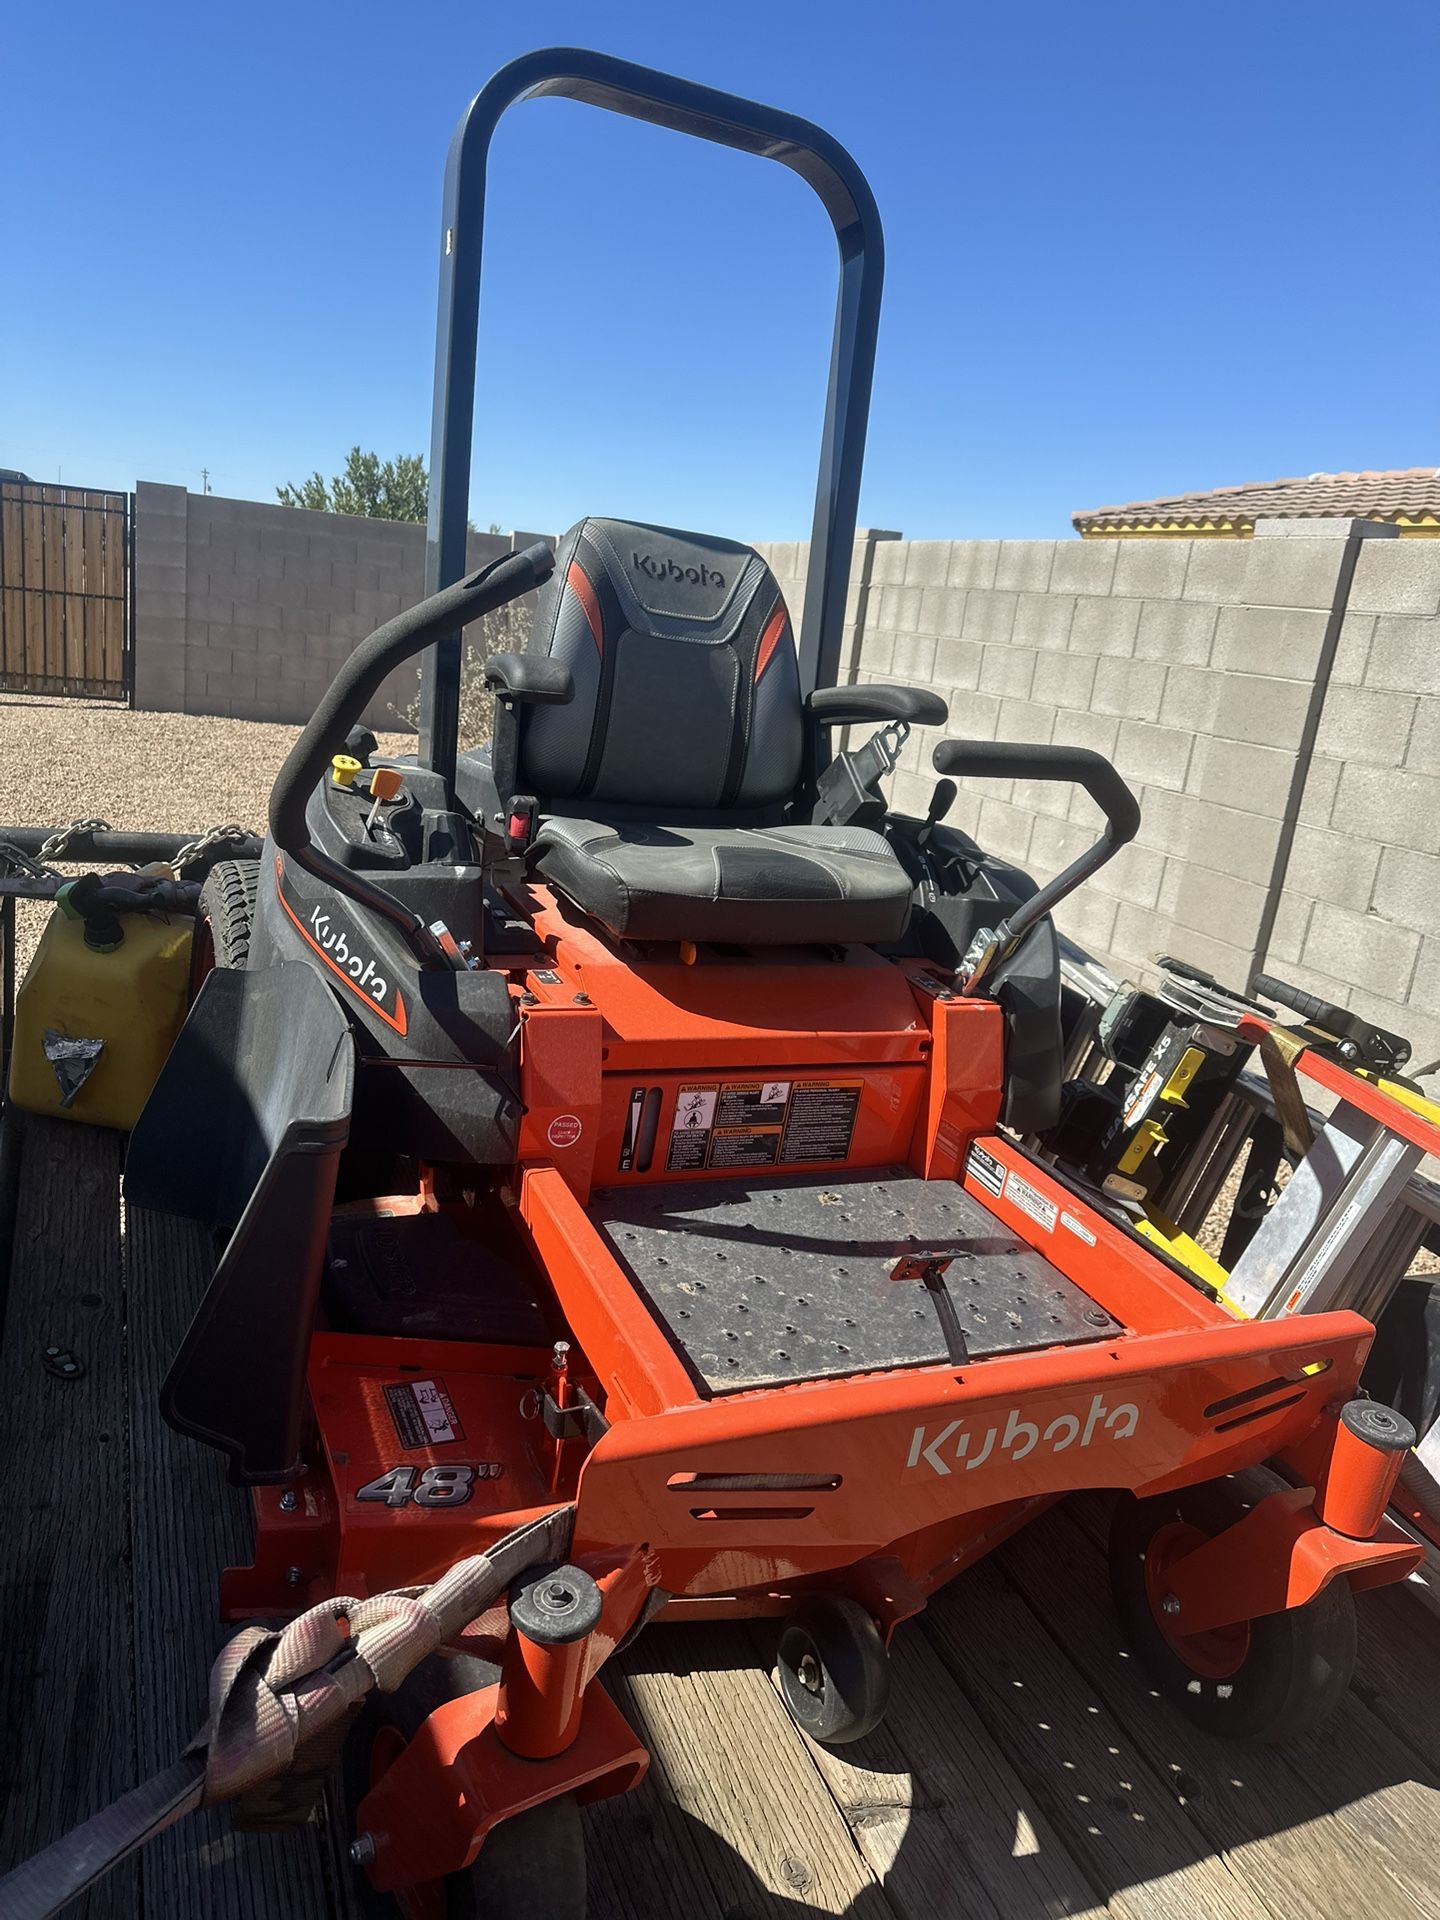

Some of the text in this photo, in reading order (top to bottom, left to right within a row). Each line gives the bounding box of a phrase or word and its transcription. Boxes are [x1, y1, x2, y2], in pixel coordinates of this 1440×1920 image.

[633, 552, 725, 588] Kubota
[310, 905, 387, 1001] Kubota
[1153, 1035, 1171, 1060] X5
[634, 1090, 643, 1100] F
[622, 1160, 631, 1169] E
[443, 1398, 458, 1425] DANGER
[907, 1394, 1139, 1476] Kubota
[355, 1463, 501, 1508] 48"
